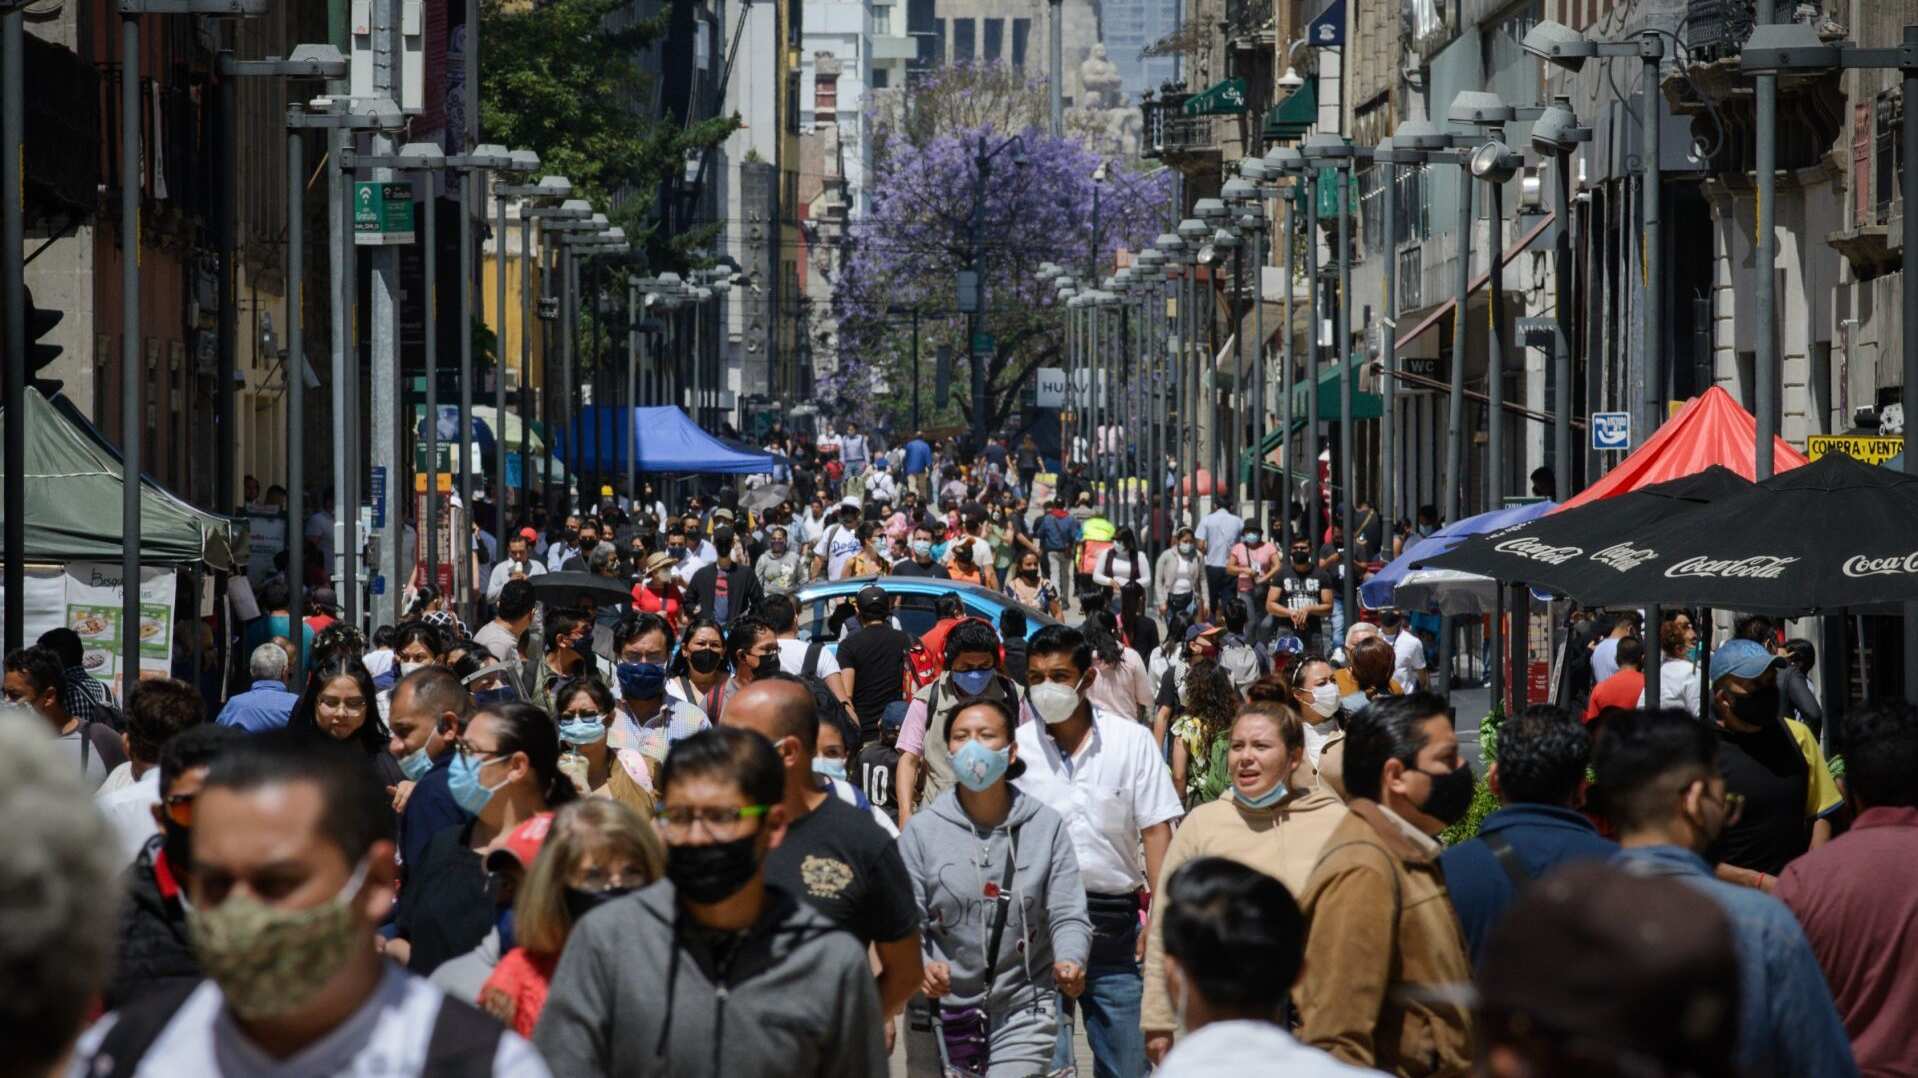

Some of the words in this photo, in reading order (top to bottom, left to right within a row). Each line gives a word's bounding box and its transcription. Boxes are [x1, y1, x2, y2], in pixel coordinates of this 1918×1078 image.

[1410, 360, 1435, 372] WC
[1812, 440, 1861, 454] COMPRA
[1494, 537, 1583, 565] Coca-Cola
[1664, 555, 1800, 578] Coca-Cola
[862, 762, 888, 806] 10
